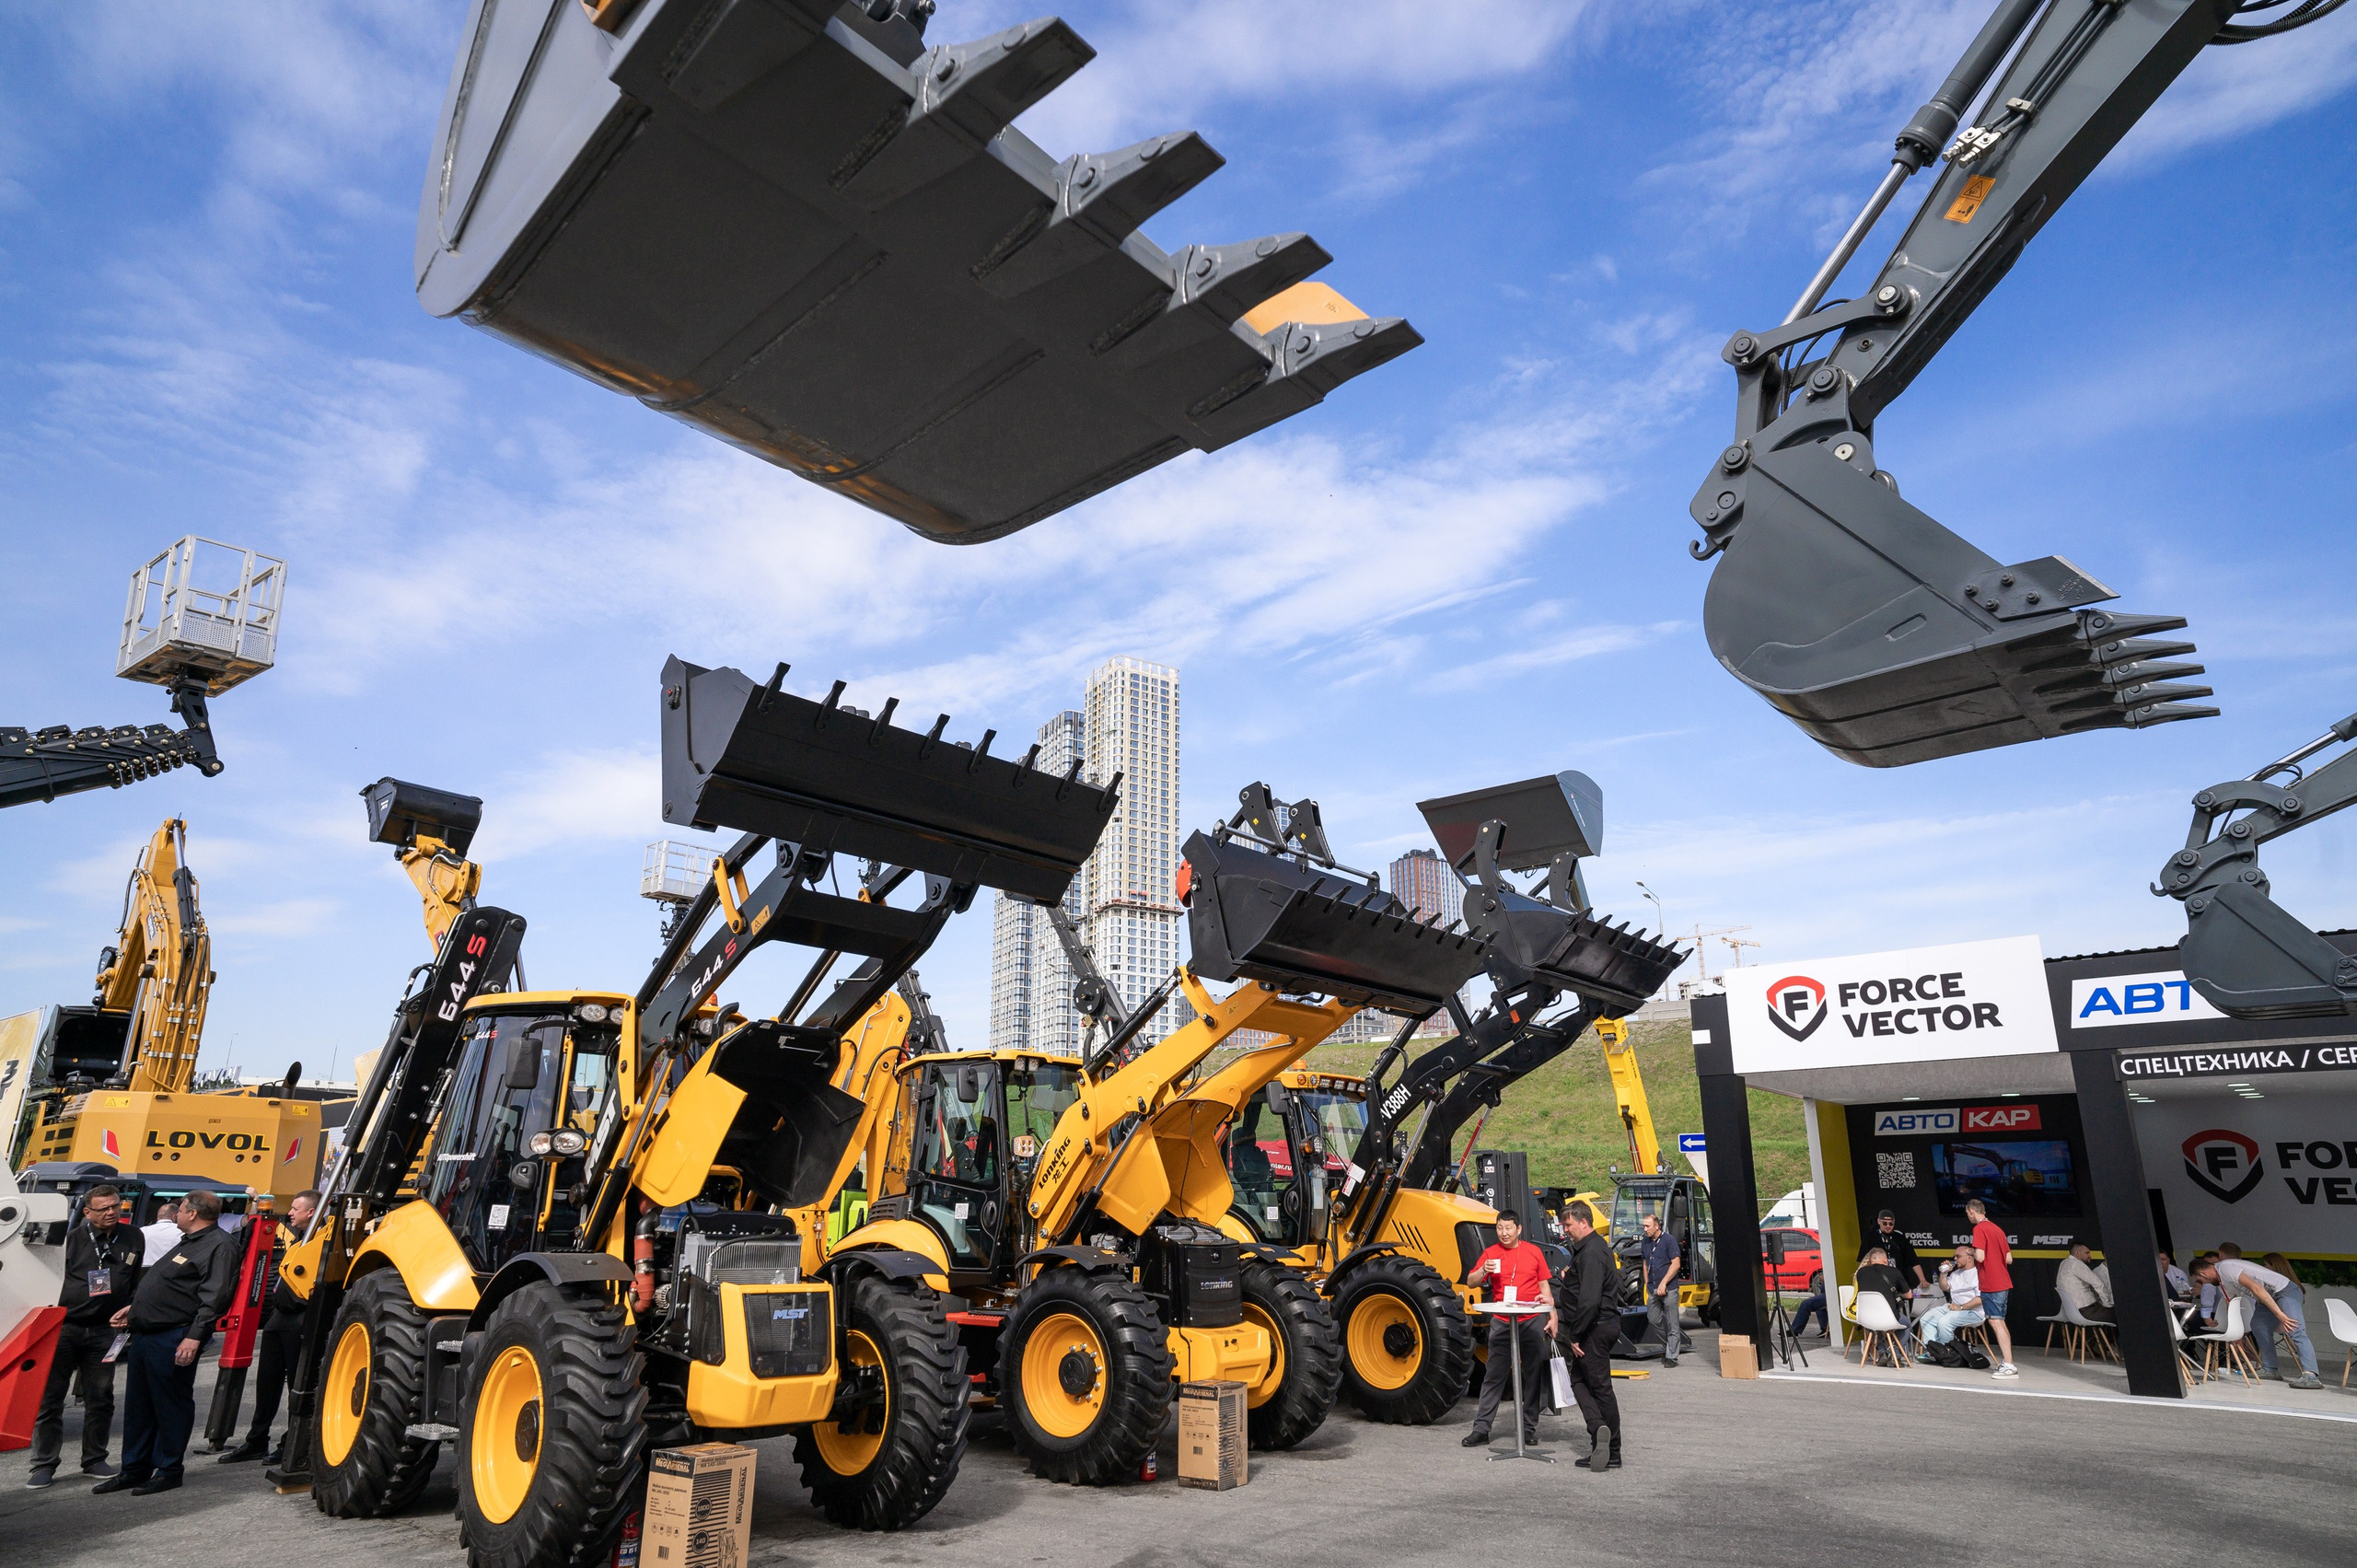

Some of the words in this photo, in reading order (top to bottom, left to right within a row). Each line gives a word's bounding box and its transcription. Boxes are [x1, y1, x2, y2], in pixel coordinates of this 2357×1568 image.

[691, 954, 725, 999] 644
[1838, 971, 1966, 1007] FORCE
[438, 960, 477, 1022] 644
[2079, 980, 2191, 1018] АВТ
[1841, 1002, 2004, 1039] VECTOR
[2120, 1050, 2294, 1076] СПЕЦТЕХНИКА
[1878, 1112, 1955, 1132] АВТО
[1968, 1109, 2031, 1128] КАР
[145, 1130, 271, 1152] LOVOL
[2283, 1177, 2357, 1206] VE
[2032, 1235, 2073, 1245] MST
[773, 1308, 809, 1320] MST
